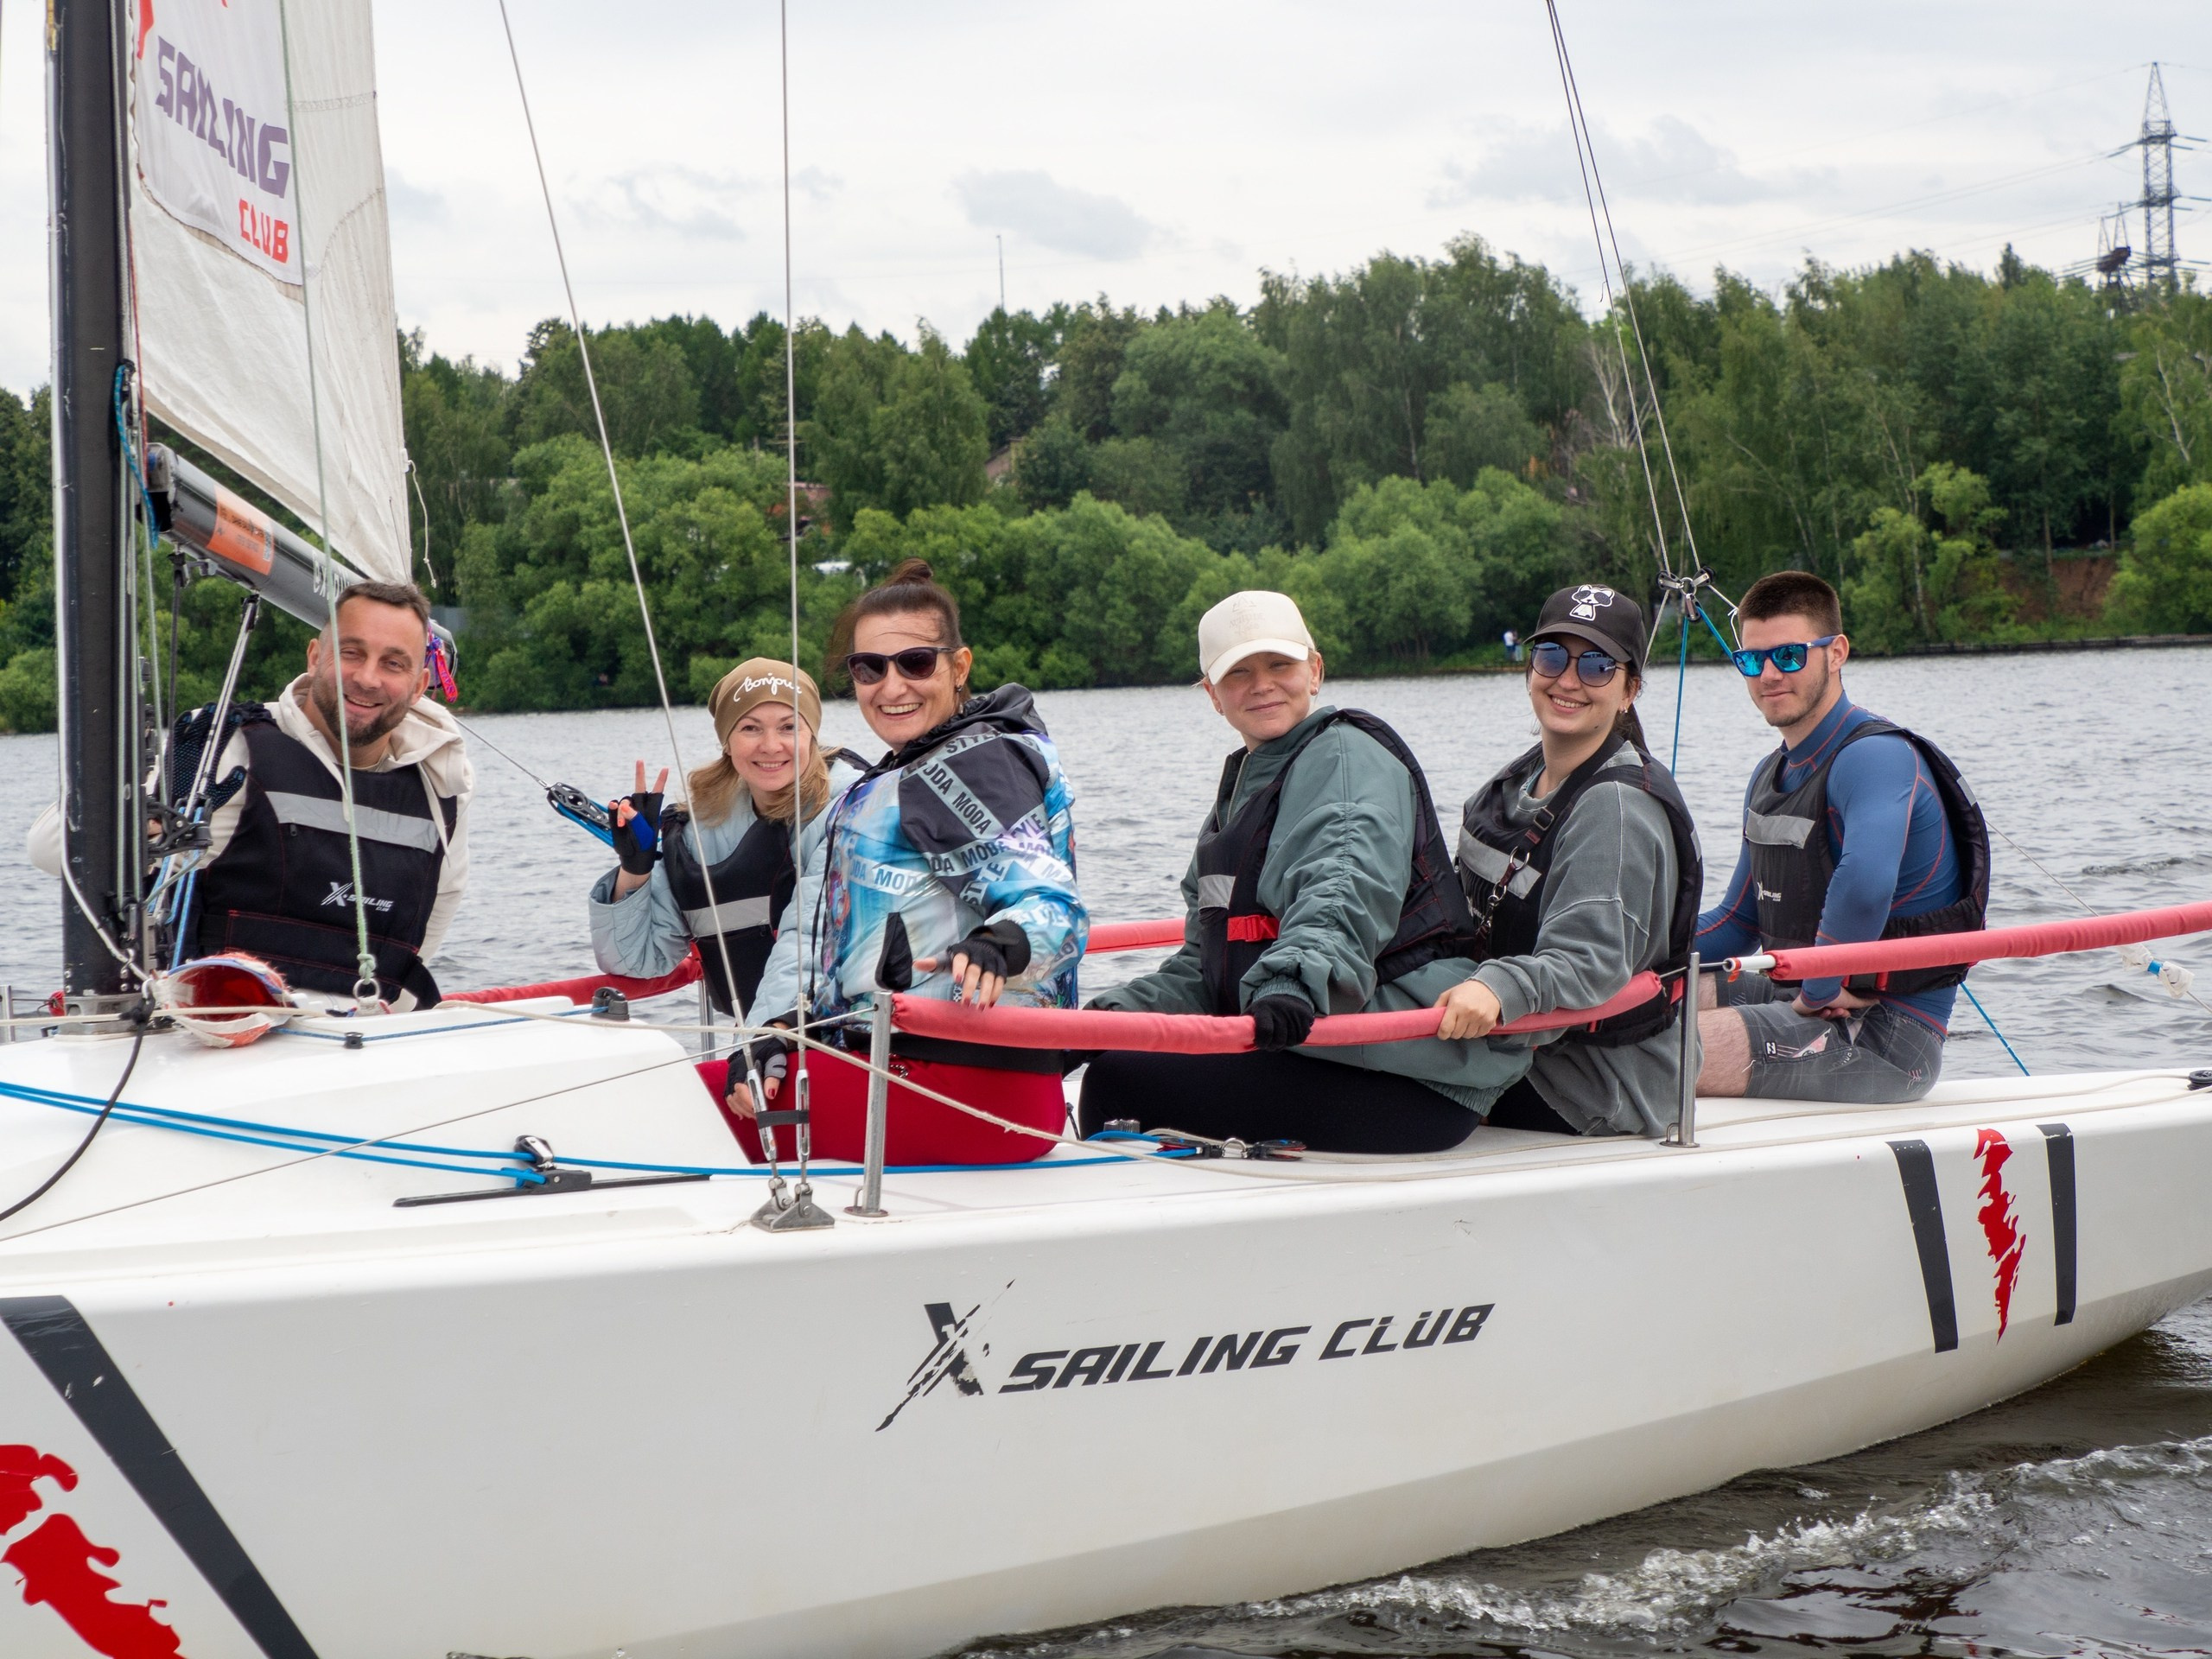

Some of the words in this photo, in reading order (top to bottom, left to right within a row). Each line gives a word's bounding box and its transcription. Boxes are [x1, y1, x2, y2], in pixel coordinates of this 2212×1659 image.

[156, 35, 290, 199] SAILING
[238, 198, 289, 264] CLUB
[951, 791, 992, 835] MODA
[997, 1325, 1312, 1395] SAILING
[1319, 1303, 1496, 1360] CLUB
